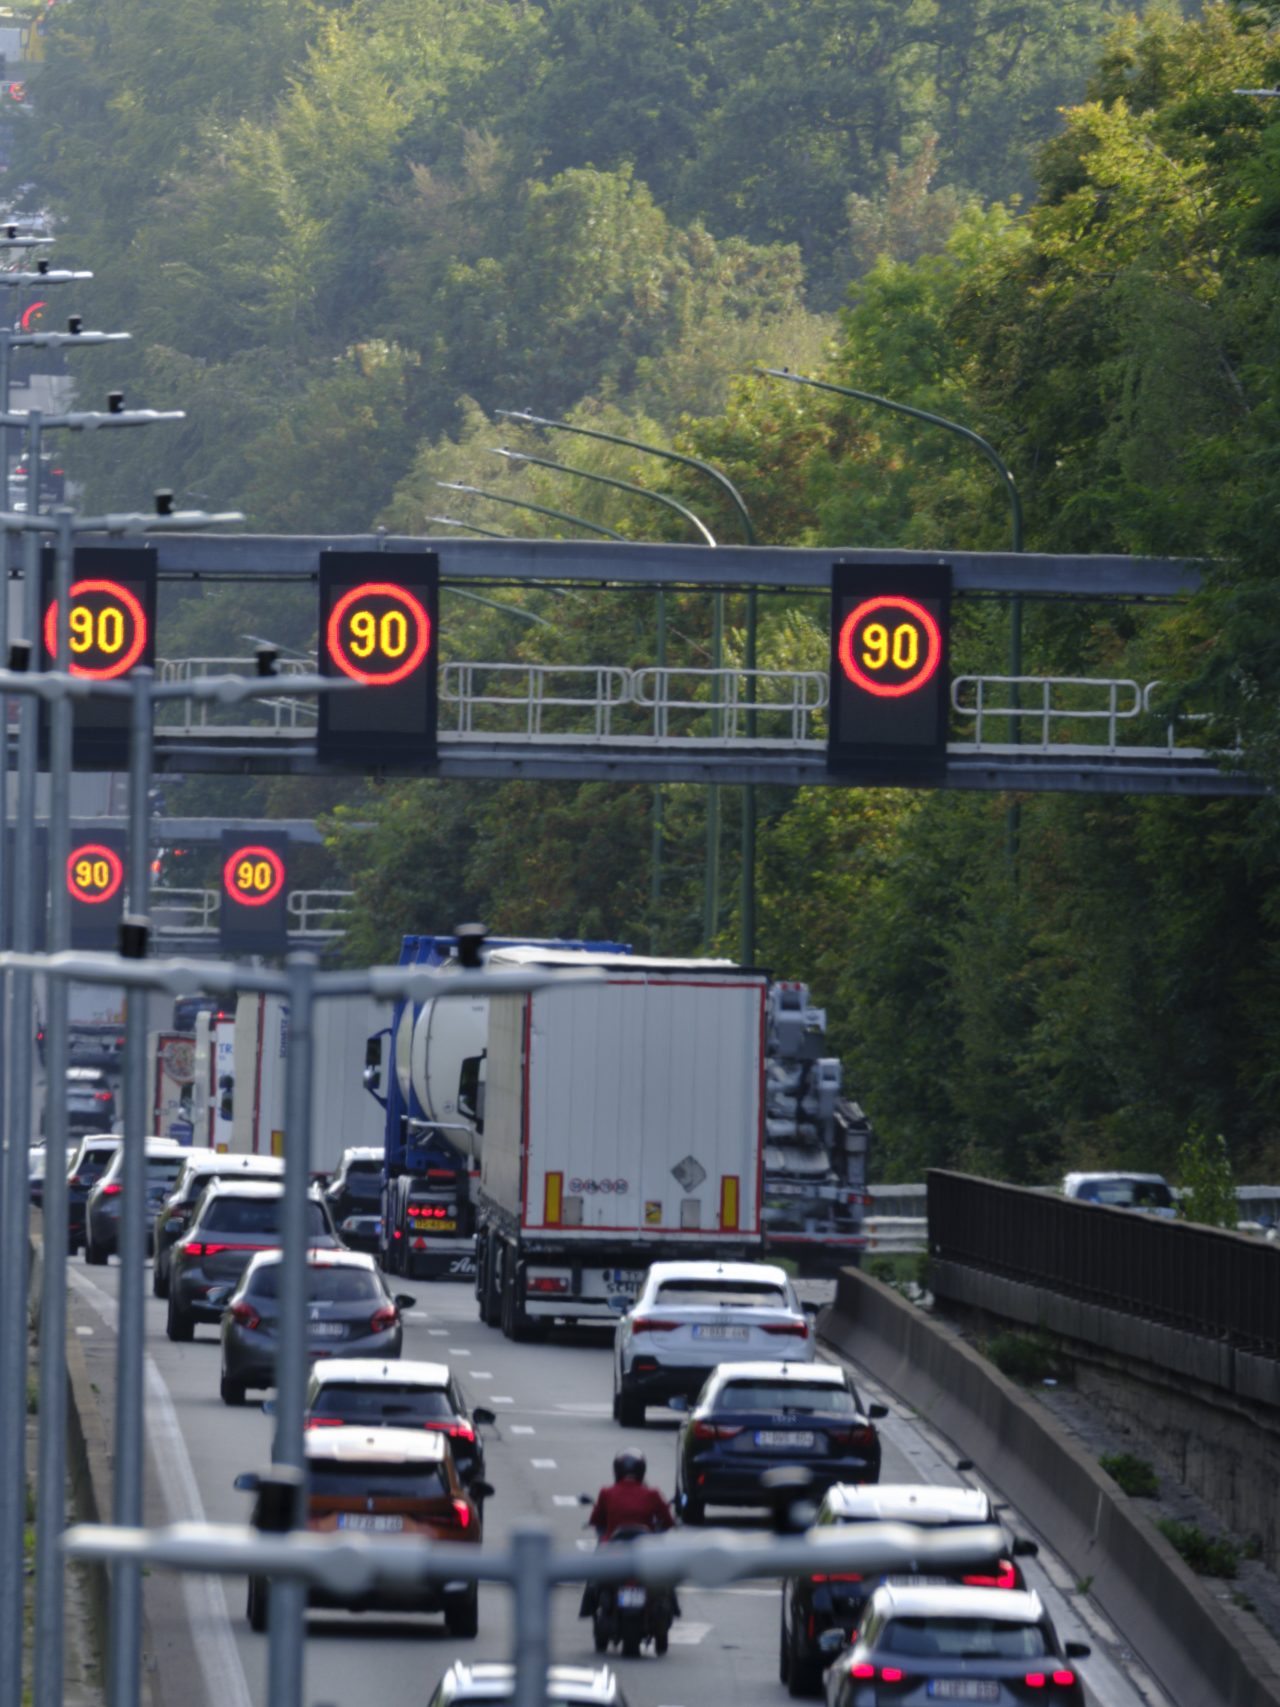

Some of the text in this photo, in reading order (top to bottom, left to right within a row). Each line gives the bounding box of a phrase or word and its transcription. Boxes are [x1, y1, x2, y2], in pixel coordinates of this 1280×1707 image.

[69, 606, 123, 652] 90
[350, 610, 406, 656] 90
[863, 623, 917, 668] 90
[76, 861, 109, 888] 90
[238, 862, 271, 889] 90
